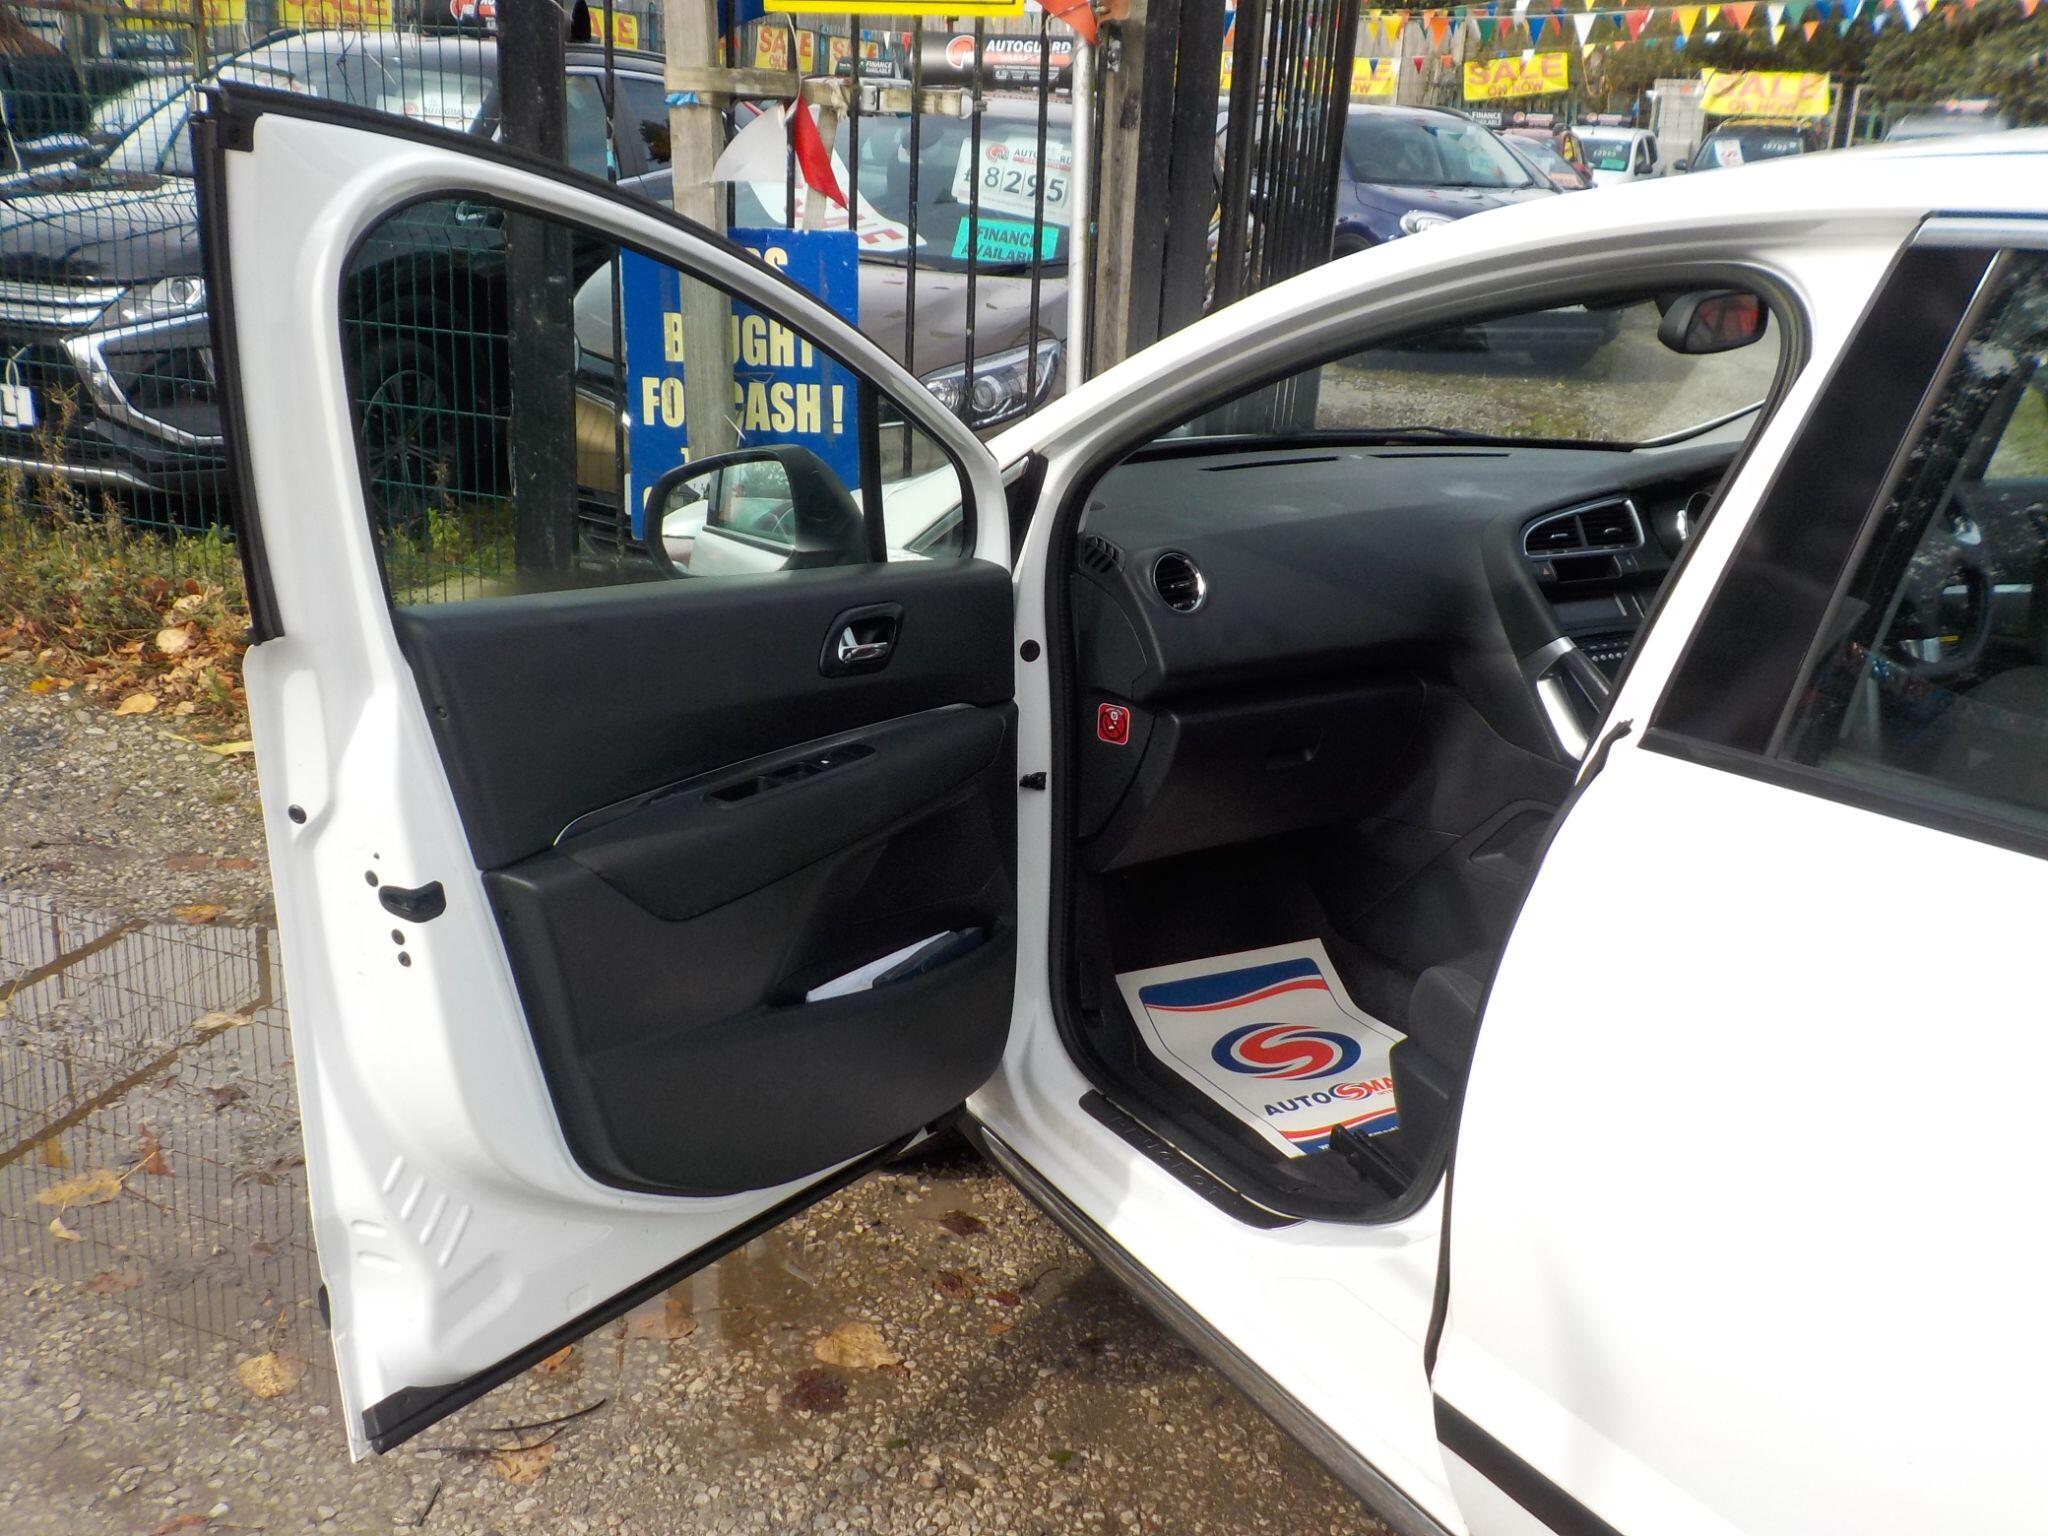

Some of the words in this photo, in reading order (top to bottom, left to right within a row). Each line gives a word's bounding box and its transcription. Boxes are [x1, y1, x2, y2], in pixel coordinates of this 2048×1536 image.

[759, 27, 812, 57] SAE
[985, 39, 1072, 54] AUTOGURD
[1468, 52, 1563, 86] SALE
[1512, 78, 1544, 93] NOW
[641, 376, 685, 428] FO
